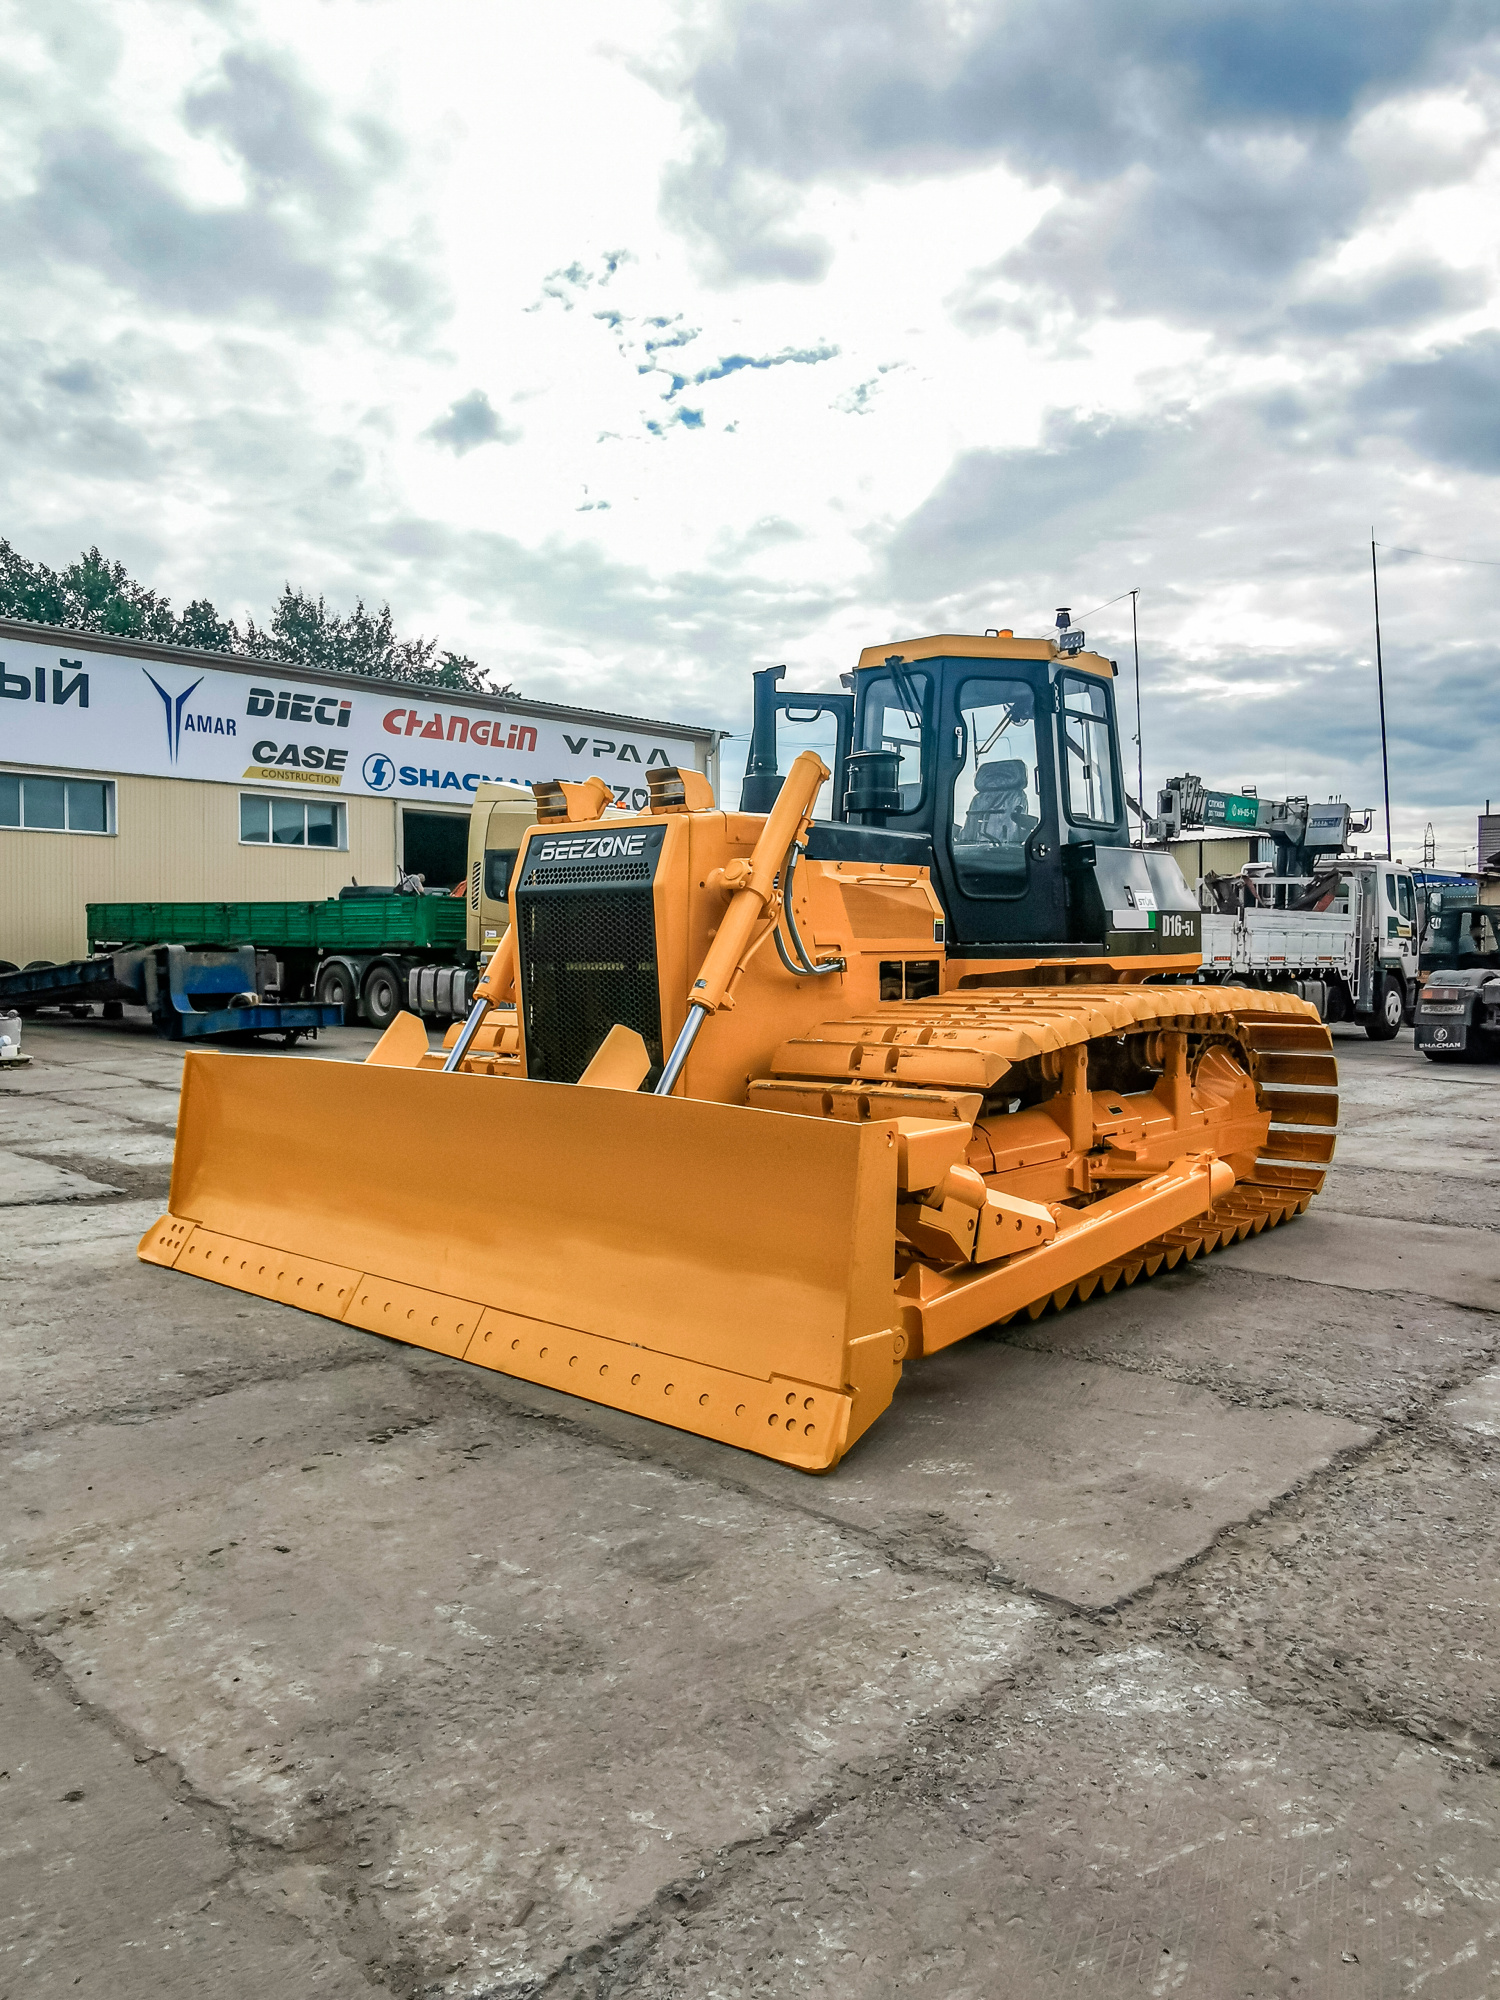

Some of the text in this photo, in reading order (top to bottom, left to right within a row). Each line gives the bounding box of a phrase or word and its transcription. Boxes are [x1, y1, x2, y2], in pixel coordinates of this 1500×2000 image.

[252, 740, 349, 772] CASE
[261, 769, 340, 785] CONSTRUCTION
[398, 766, 543, 793] SHAC
[540, 834, 647, 862] BEEZONE
